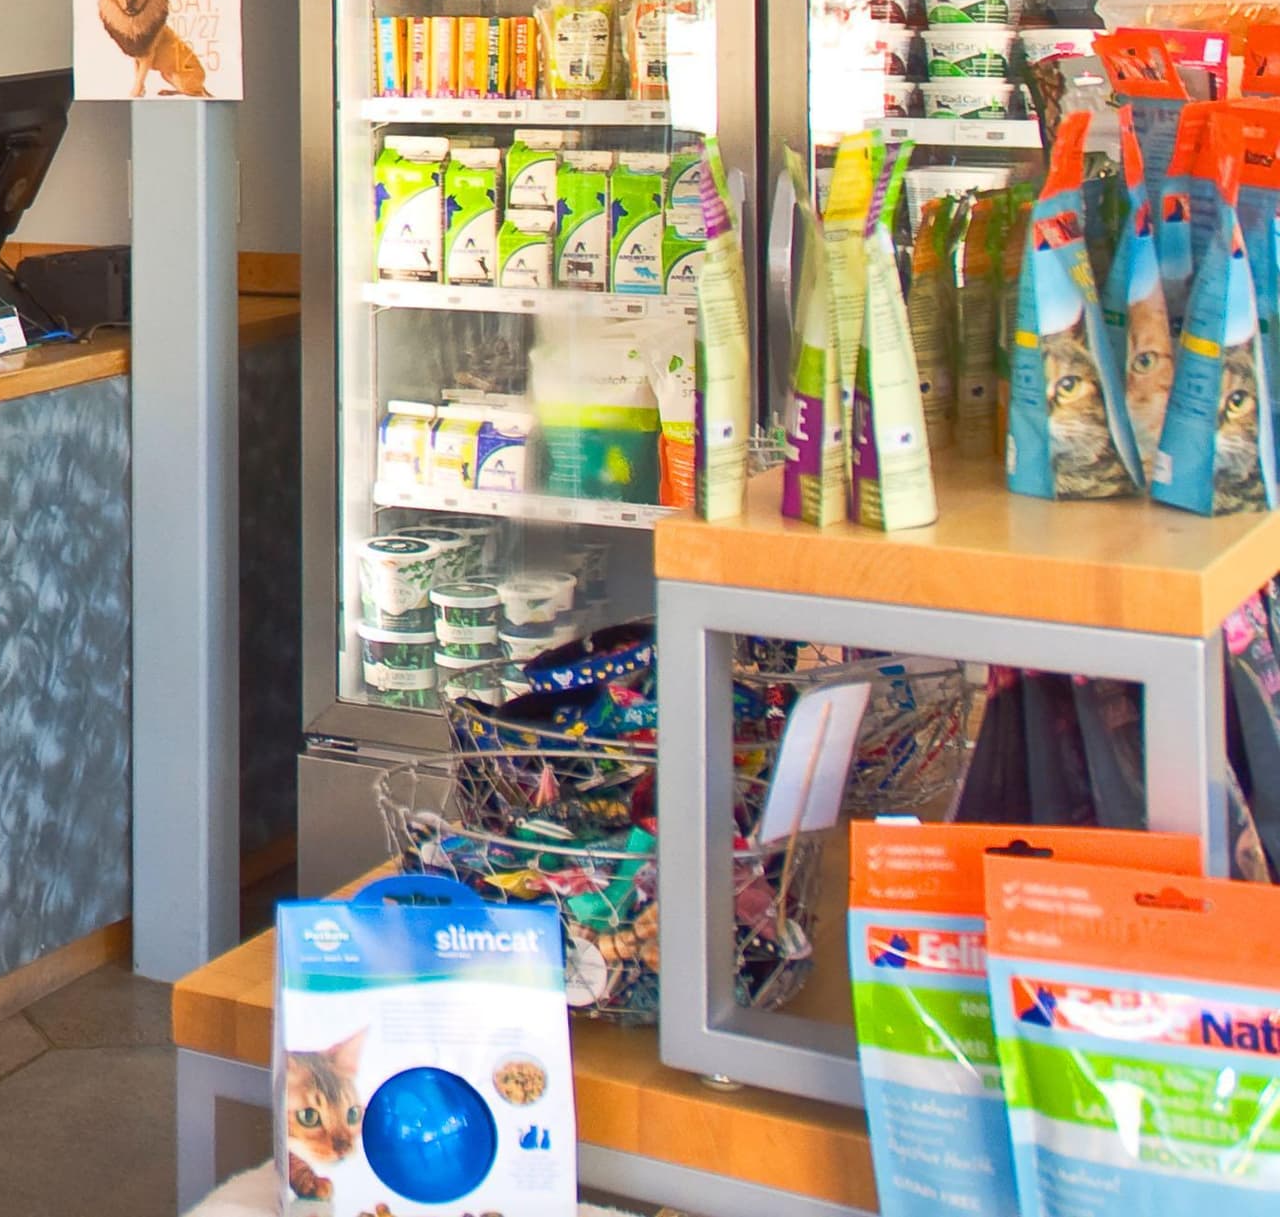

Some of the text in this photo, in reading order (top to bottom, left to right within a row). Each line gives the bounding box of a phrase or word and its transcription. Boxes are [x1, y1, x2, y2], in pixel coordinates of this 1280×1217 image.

[171, 15, 220, 39] 10/27
[434, 923, 539, 953] slimcat
[918, 933, 986, 971] Feli
[1200, 1010, 1280, 1055] Nat
